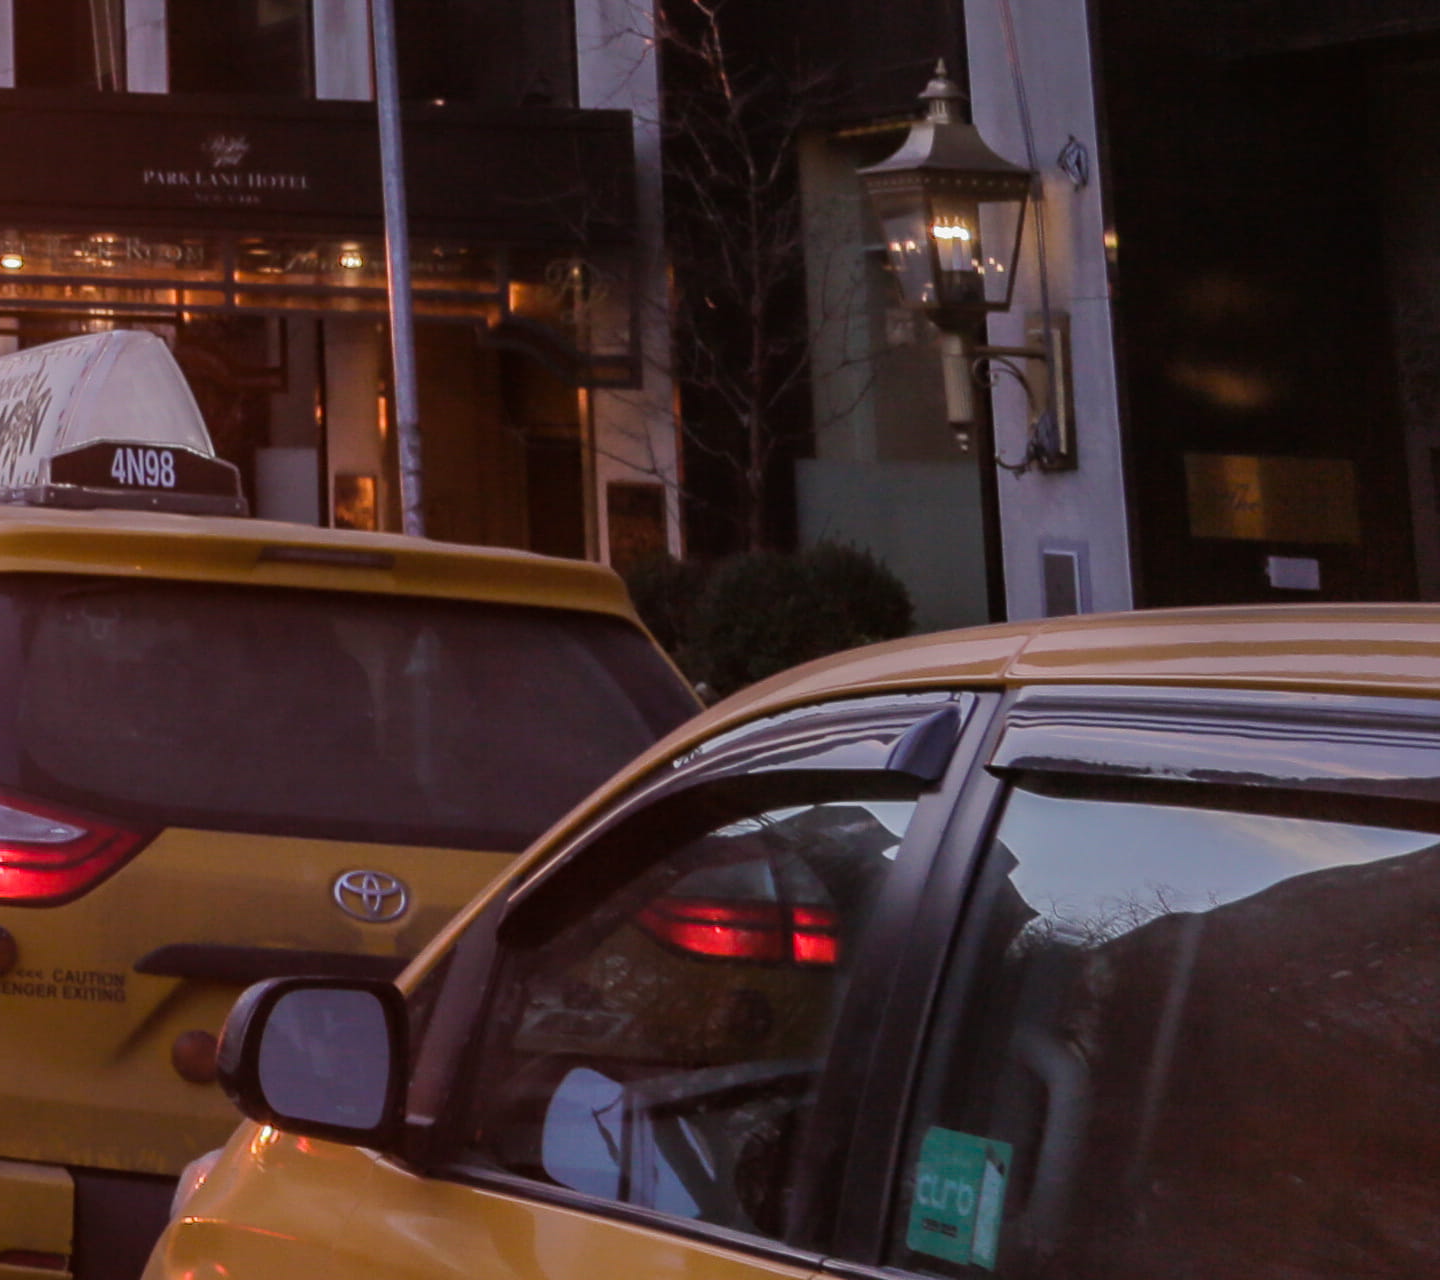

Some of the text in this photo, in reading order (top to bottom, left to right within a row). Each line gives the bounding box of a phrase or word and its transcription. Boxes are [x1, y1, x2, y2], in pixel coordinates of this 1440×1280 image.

[143, 170, 312, 190] PARK LANE HOTEL
[126, 236, 206, 264] ROOM
[111, 447, 177, 488] 4N98
[53, 969, 125, 987] CAUTION
[62, 985, 126, 1003] EXITING
[917, 1173, 973, 1216] curb
